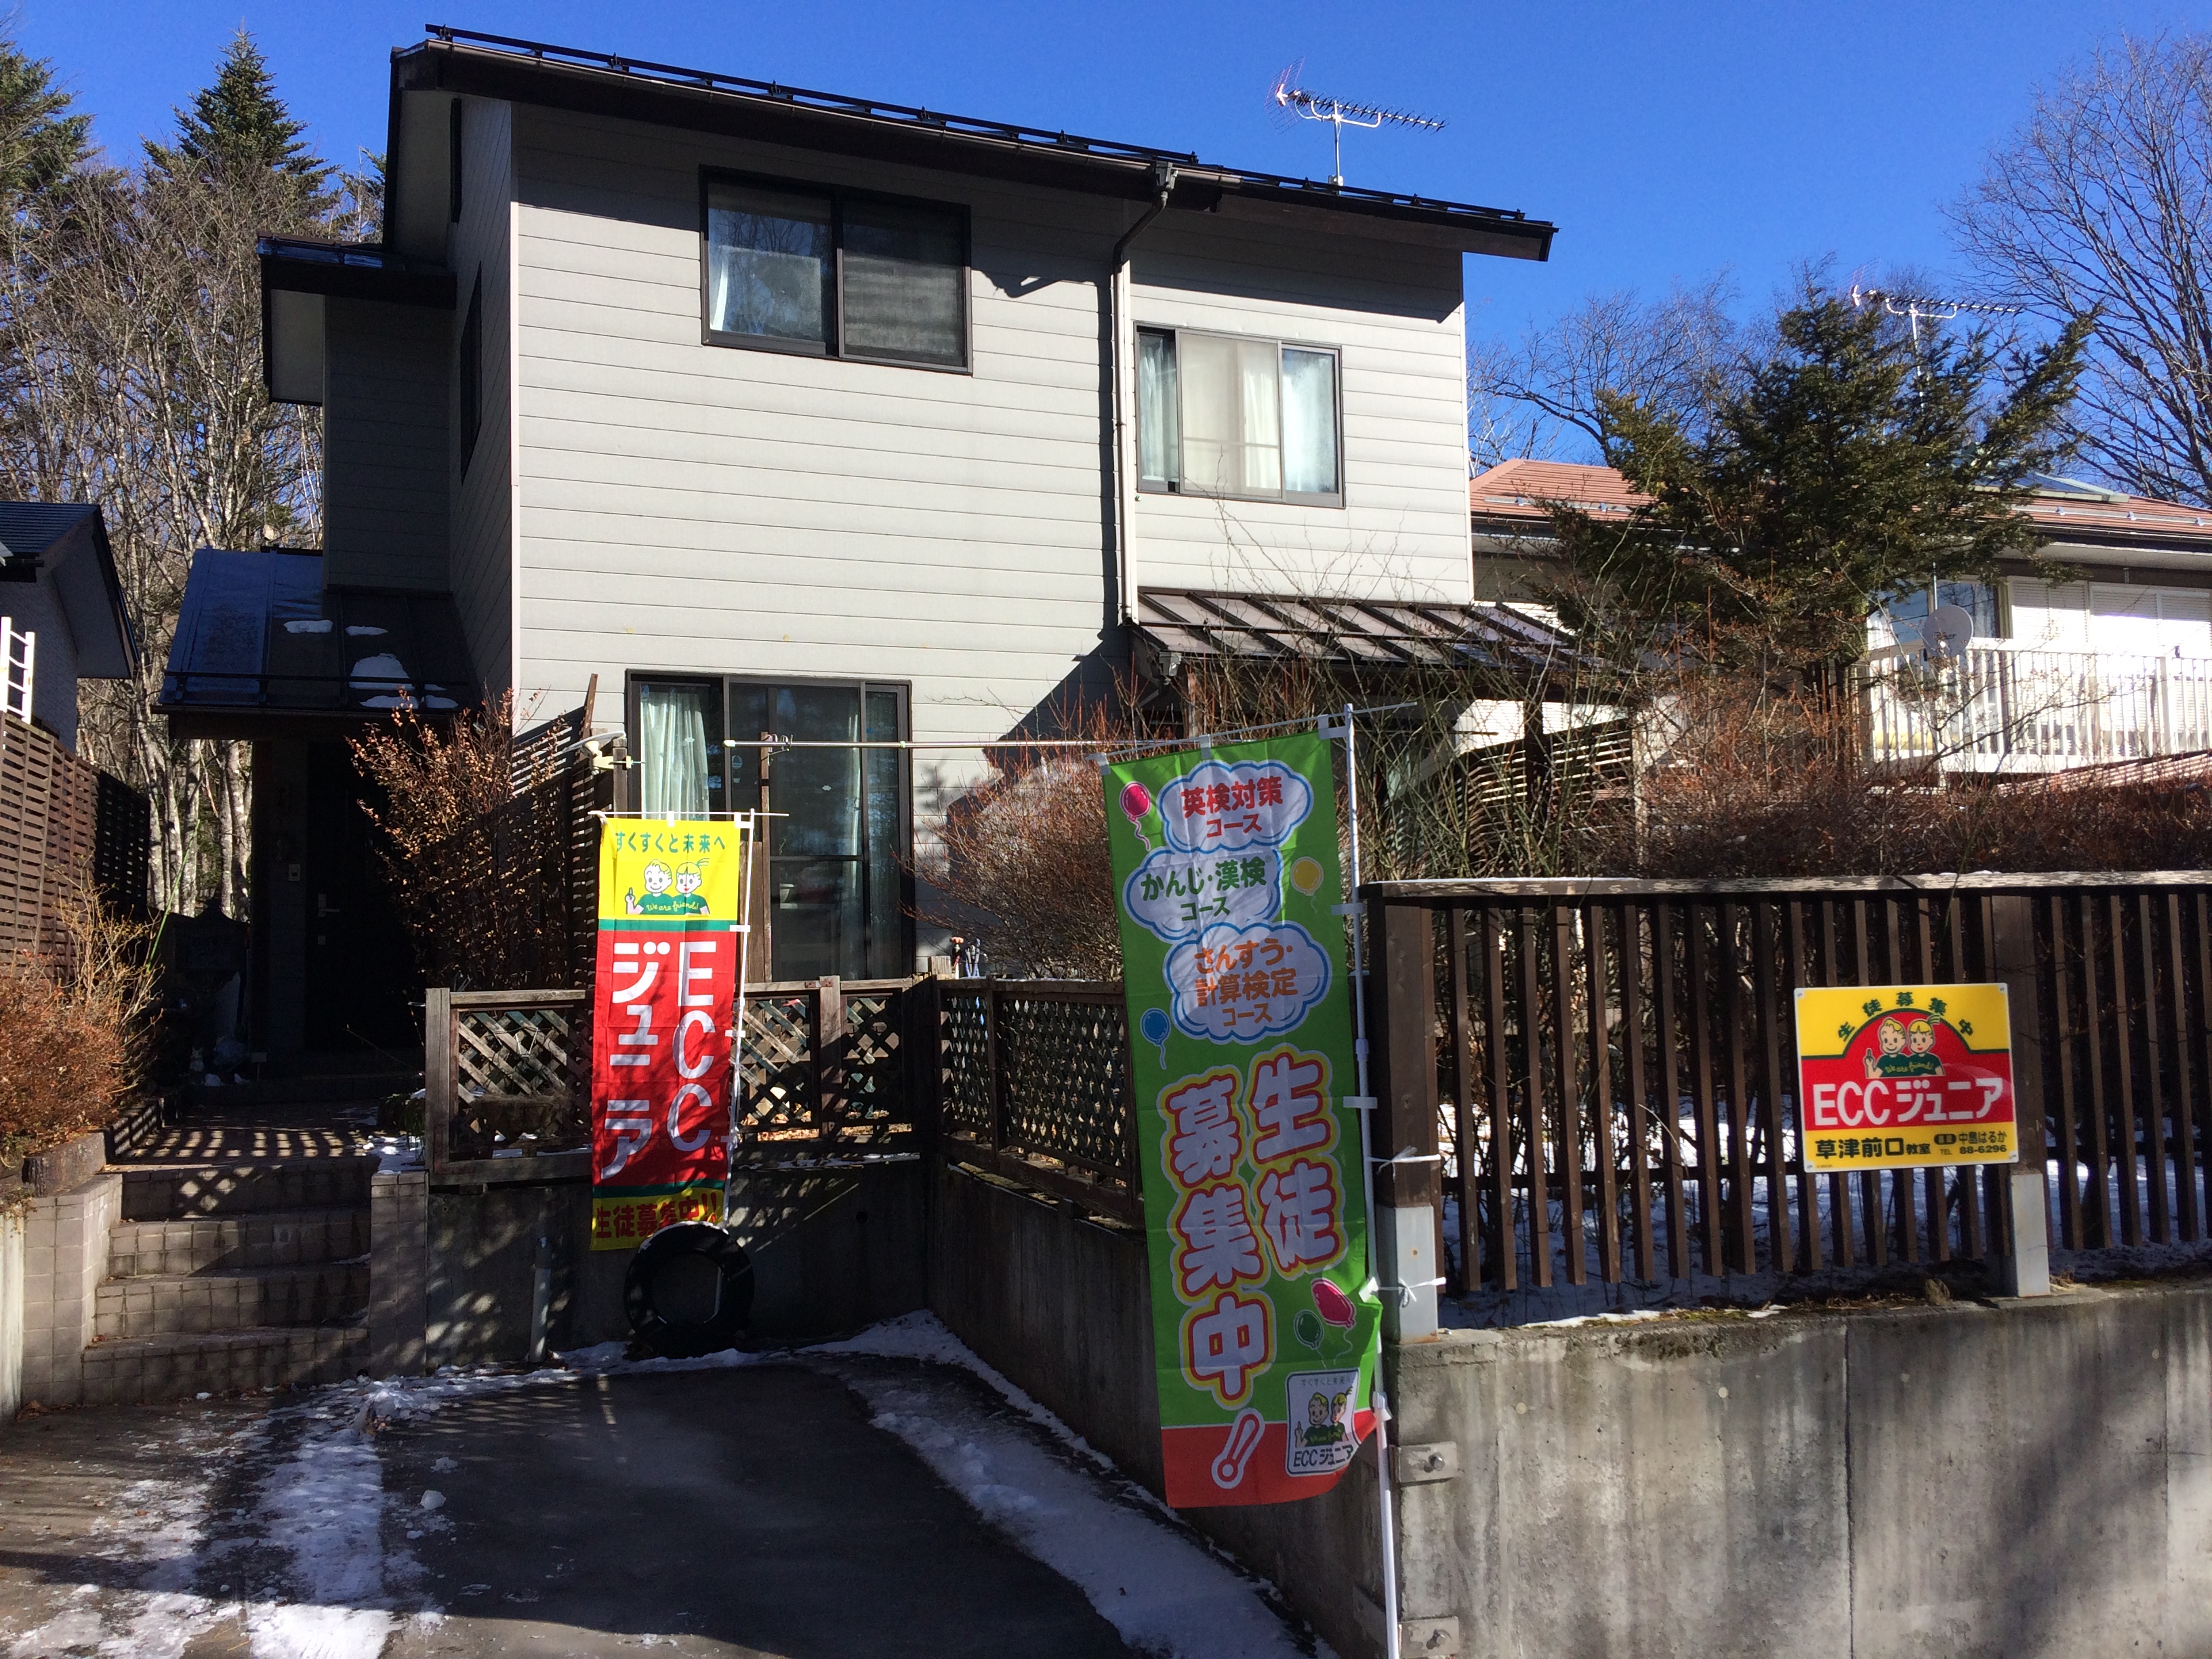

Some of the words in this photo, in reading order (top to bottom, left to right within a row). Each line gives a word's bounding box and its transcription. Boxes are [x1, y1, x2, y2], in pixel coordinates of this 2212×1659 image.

[1181, 775, 1283, 819] 英検対策
[615, 831, 725, 853] すくすくと未来へ
[1206, 813, 1263, 838] コース
[646, 903, 658, 912] We
[1180, 897, 1231, 921] コース
[1195, 966, 1298, 1008] 計算検定
[1221, 1002, 1273, 1027] コース
[1837, 991, 1973, 1042] 生徒募集中
[600, 941, 670, 1181] ジュニア
[667, 941, 716, 1152] ECC
[1249, 1051, 1342, 1274] 生徒
[1959, 1144, 2007, 1155] 88-6296
